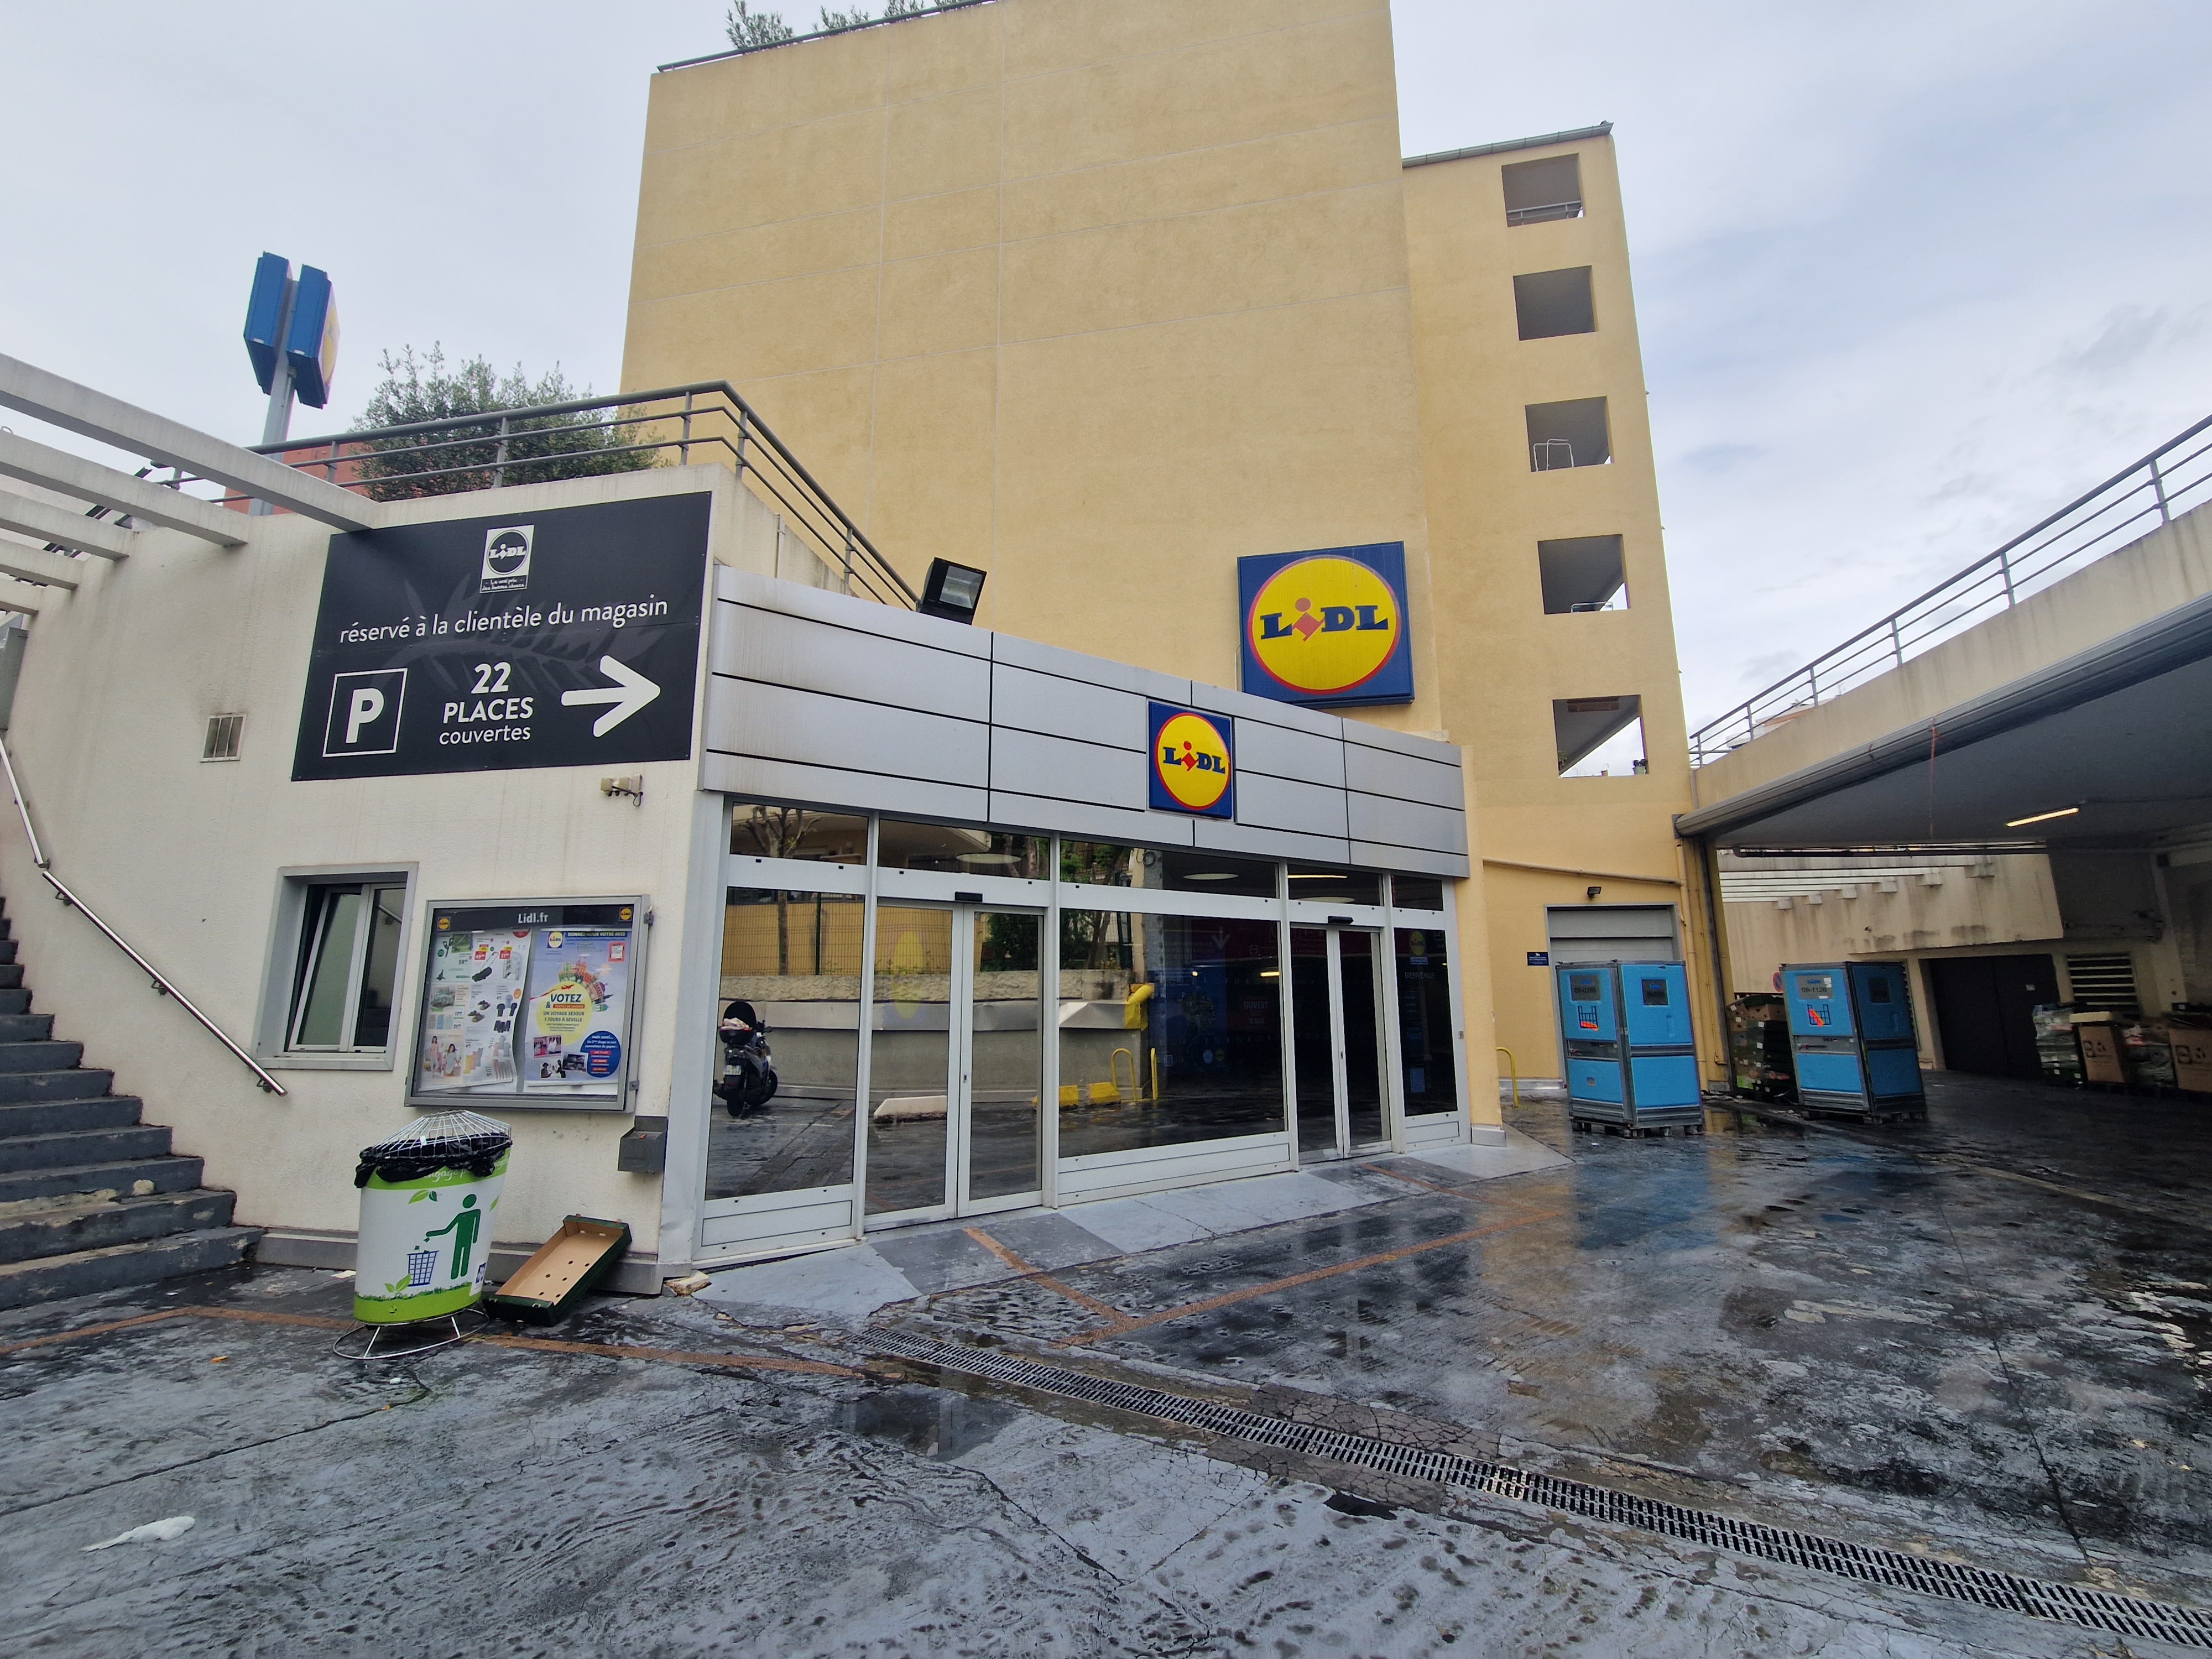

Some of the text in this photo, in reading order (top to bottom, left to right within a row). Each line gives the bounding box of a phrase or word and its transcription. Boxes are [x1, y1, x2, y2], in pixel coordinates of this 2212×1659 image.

[340, 594, 668, 643] réservé à la clientèle du magasin
[471, 662, 511, 694] 22
[346, 688, 384, 743] P
[443, 697, 534, 724] PLACES
[439, 725, 531, 745] couvertes
[518, 912, 549, 924] Lidl.fr
[550, 994, 582, 1003] VOTEZ
